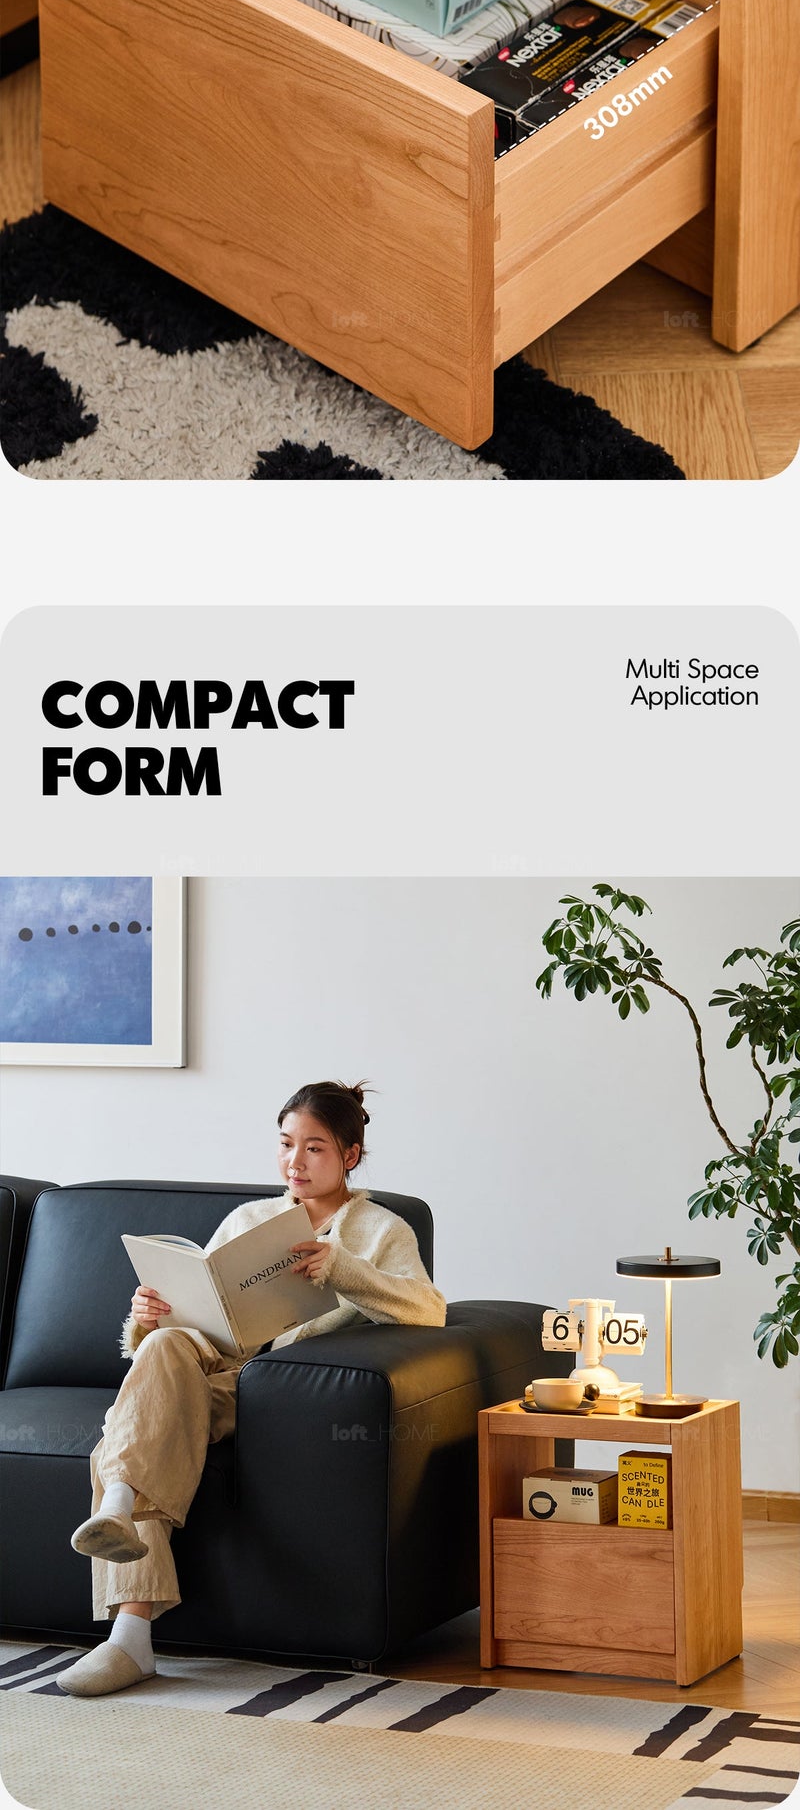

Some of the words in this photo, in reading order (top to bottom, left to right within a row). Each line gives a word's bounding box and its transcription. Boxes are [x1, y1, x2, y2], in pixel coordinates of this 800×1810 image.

[240, 1254, 303, 1291] MONDRIAN
[552, 1315, 570, 1341] 6
[605, 1319, 640, 1345] 05
[621, 1470, 665, 1485] SCENTED
[571, 1486, 594, 1497] MUG
[621, 1495, 642, 1508] CAN
[647, 1498, 665, 1509] DLE
